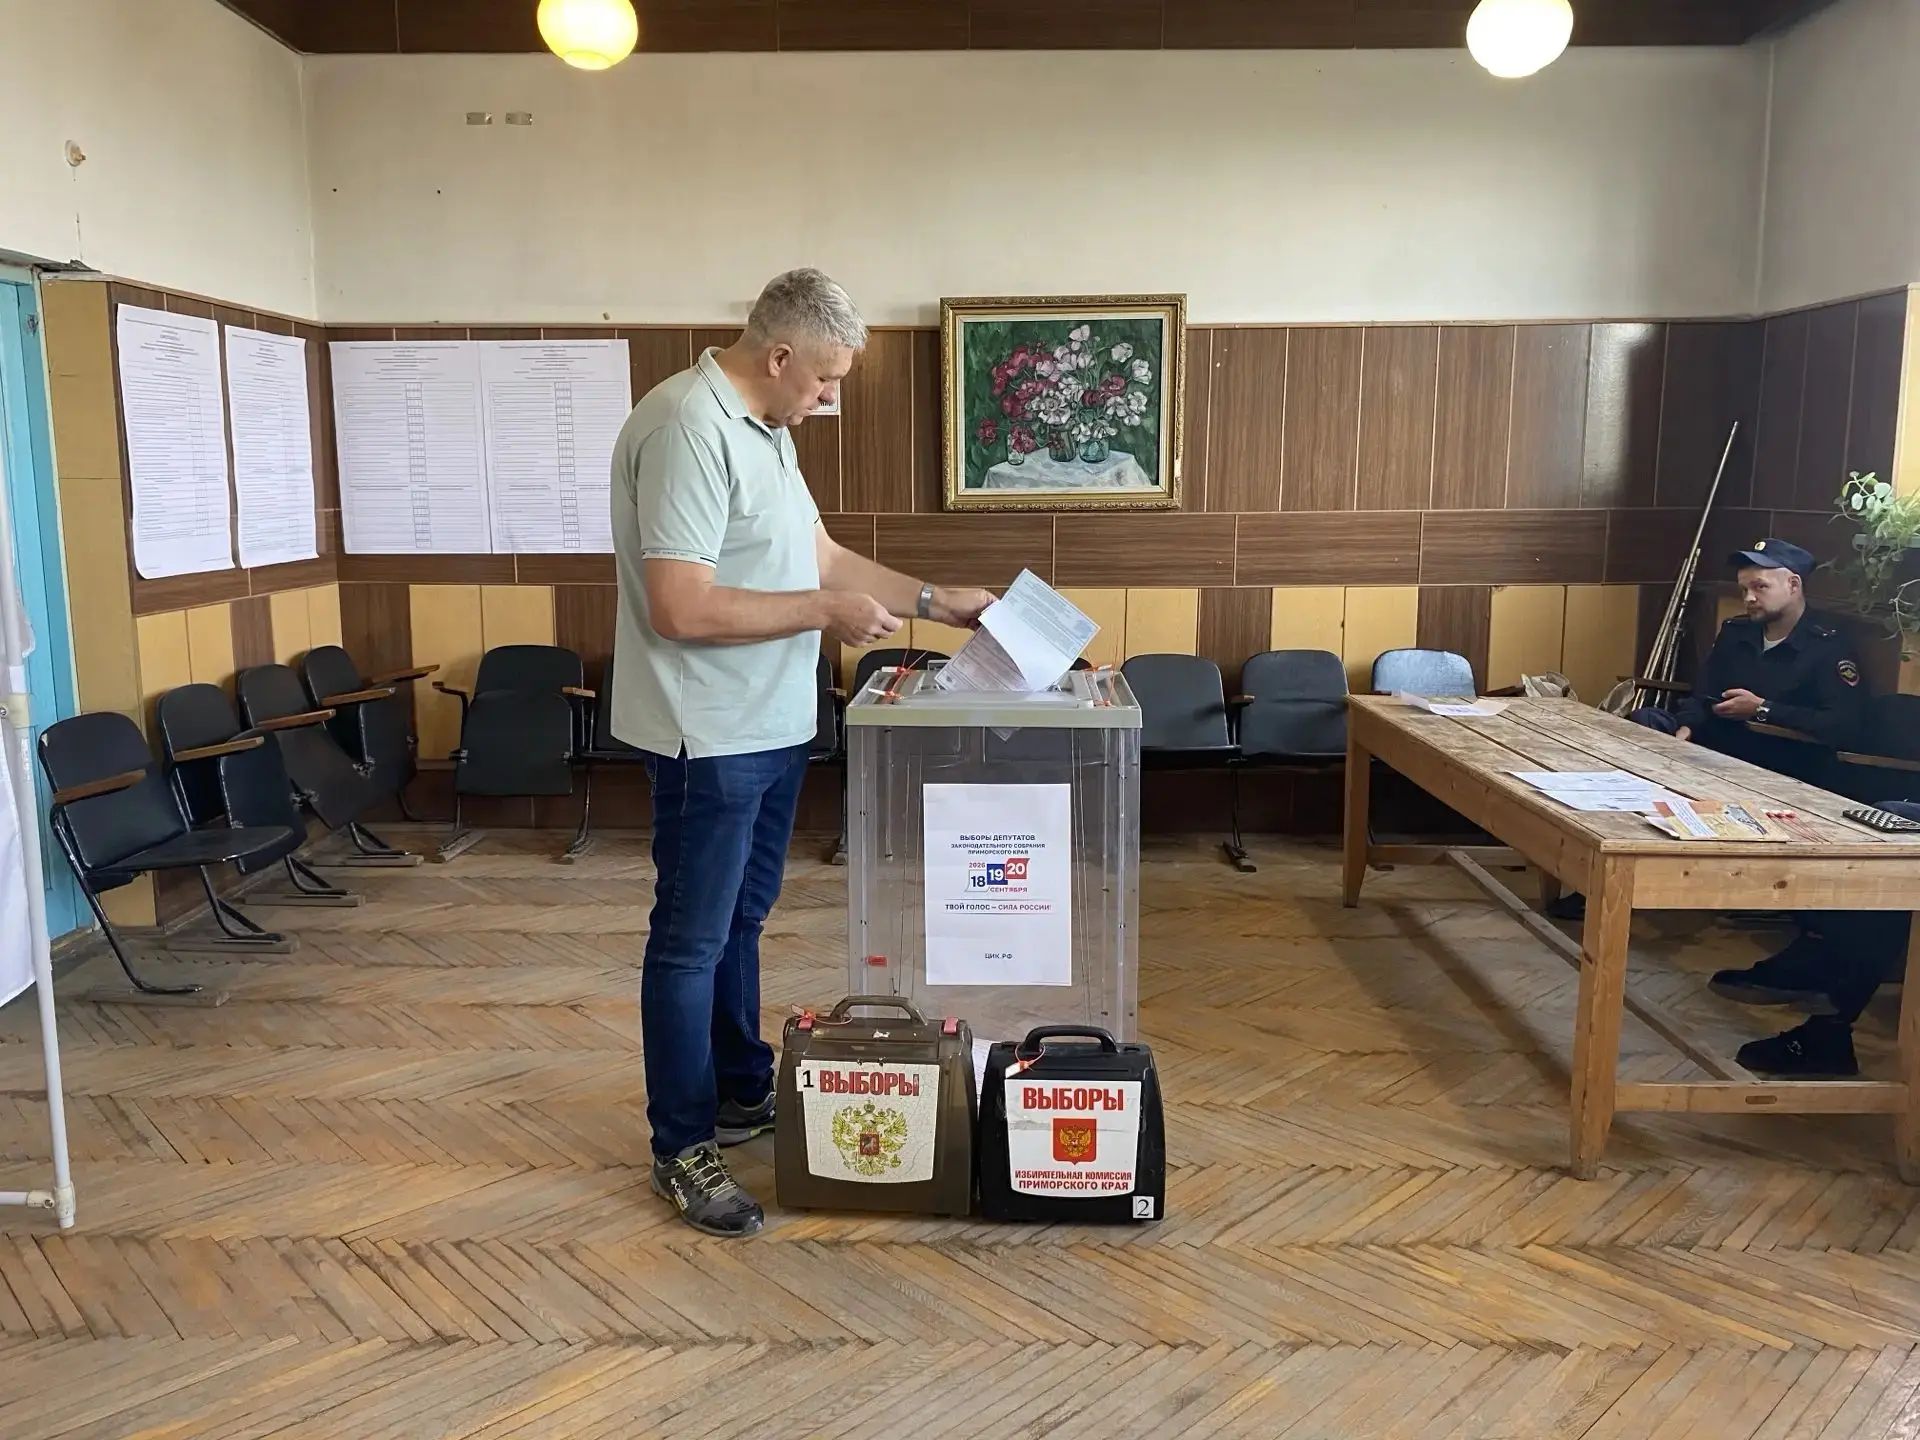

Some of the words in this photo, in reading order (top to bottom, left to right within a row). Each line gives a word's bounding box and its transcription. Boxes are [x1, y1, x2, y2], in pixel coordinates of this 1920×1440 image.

[970, 875, 986, 888] 18
[988, 868, 1004, 881] 19
[1006, 862, 1026, 875] 20
[945, 903, 965, 911] ТВОЙ
[802, 1069, 814, 1088] 1
[819, 1069, 920, 1097] ВЫБОРЫ
[1023, 1087, 1124, 1111] ВЫБОРЫ
[1014, 1170, 1083, 1180] ИЗБИРАТЕЛЬНАЯ
[1085, 1171, 1132, 1181] КОМИССИЯ
[1018, 1180, 1098, 1190] ПРИМОРСКОГО
[1101, 1181, 1129, 1191] КРАЯ
[1136, 1199, 1150, 1217] 2
